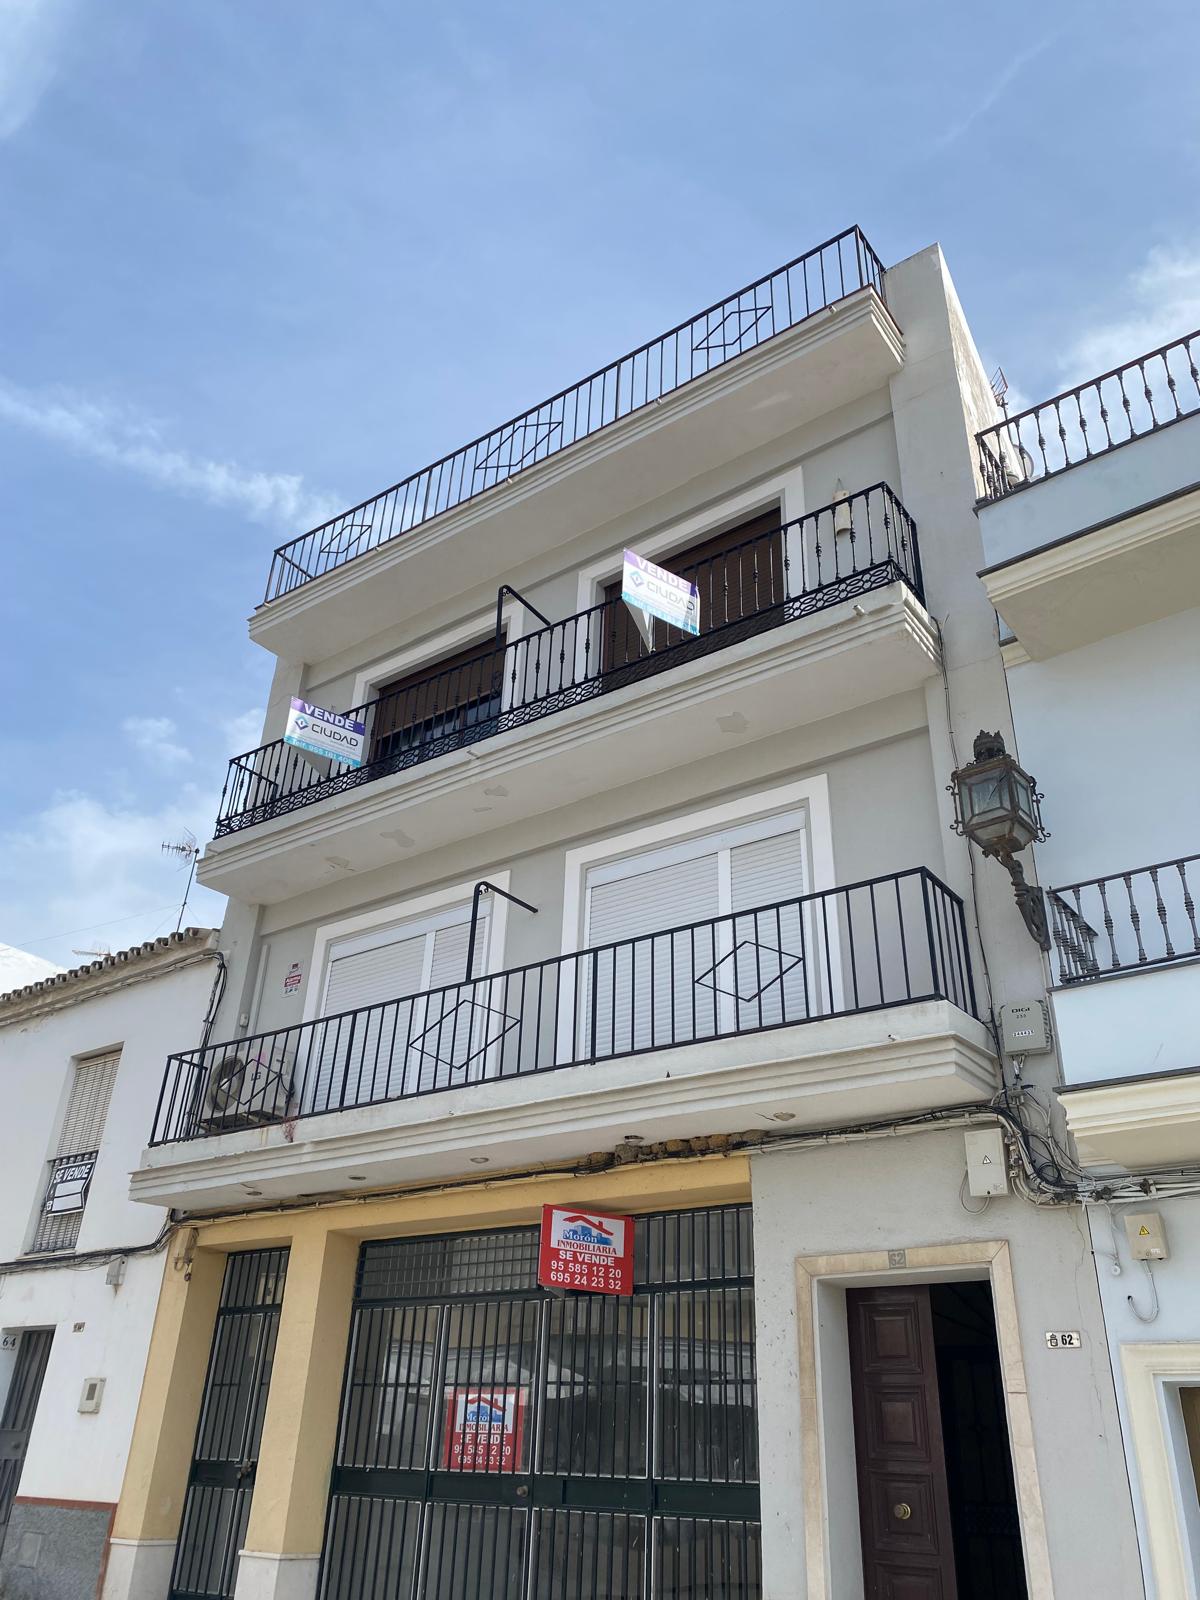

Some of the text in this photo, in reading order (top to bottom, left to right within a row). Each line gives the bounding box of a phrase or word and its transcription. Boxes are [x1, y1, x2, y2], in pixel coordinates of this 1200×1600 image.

[304, 703, 354, 731] VENDE
[311, 723, 359, 747] CIUDAD
[63, 1164, 91, 1180] VENDE
[563, 1230, 597, 1243] Morón
[557, 1240, 617, 1255] INMOBILIARIA
[559, 1250, 615, 1266] SE VENDE
[551, 1260, 622, 1278] 95 585 12 20
[550, 1271, 621, 1290] 695 24 23 32
[2, 1335, 16, 1348] 64
[1061, 1334, 1074, 1345] 62
